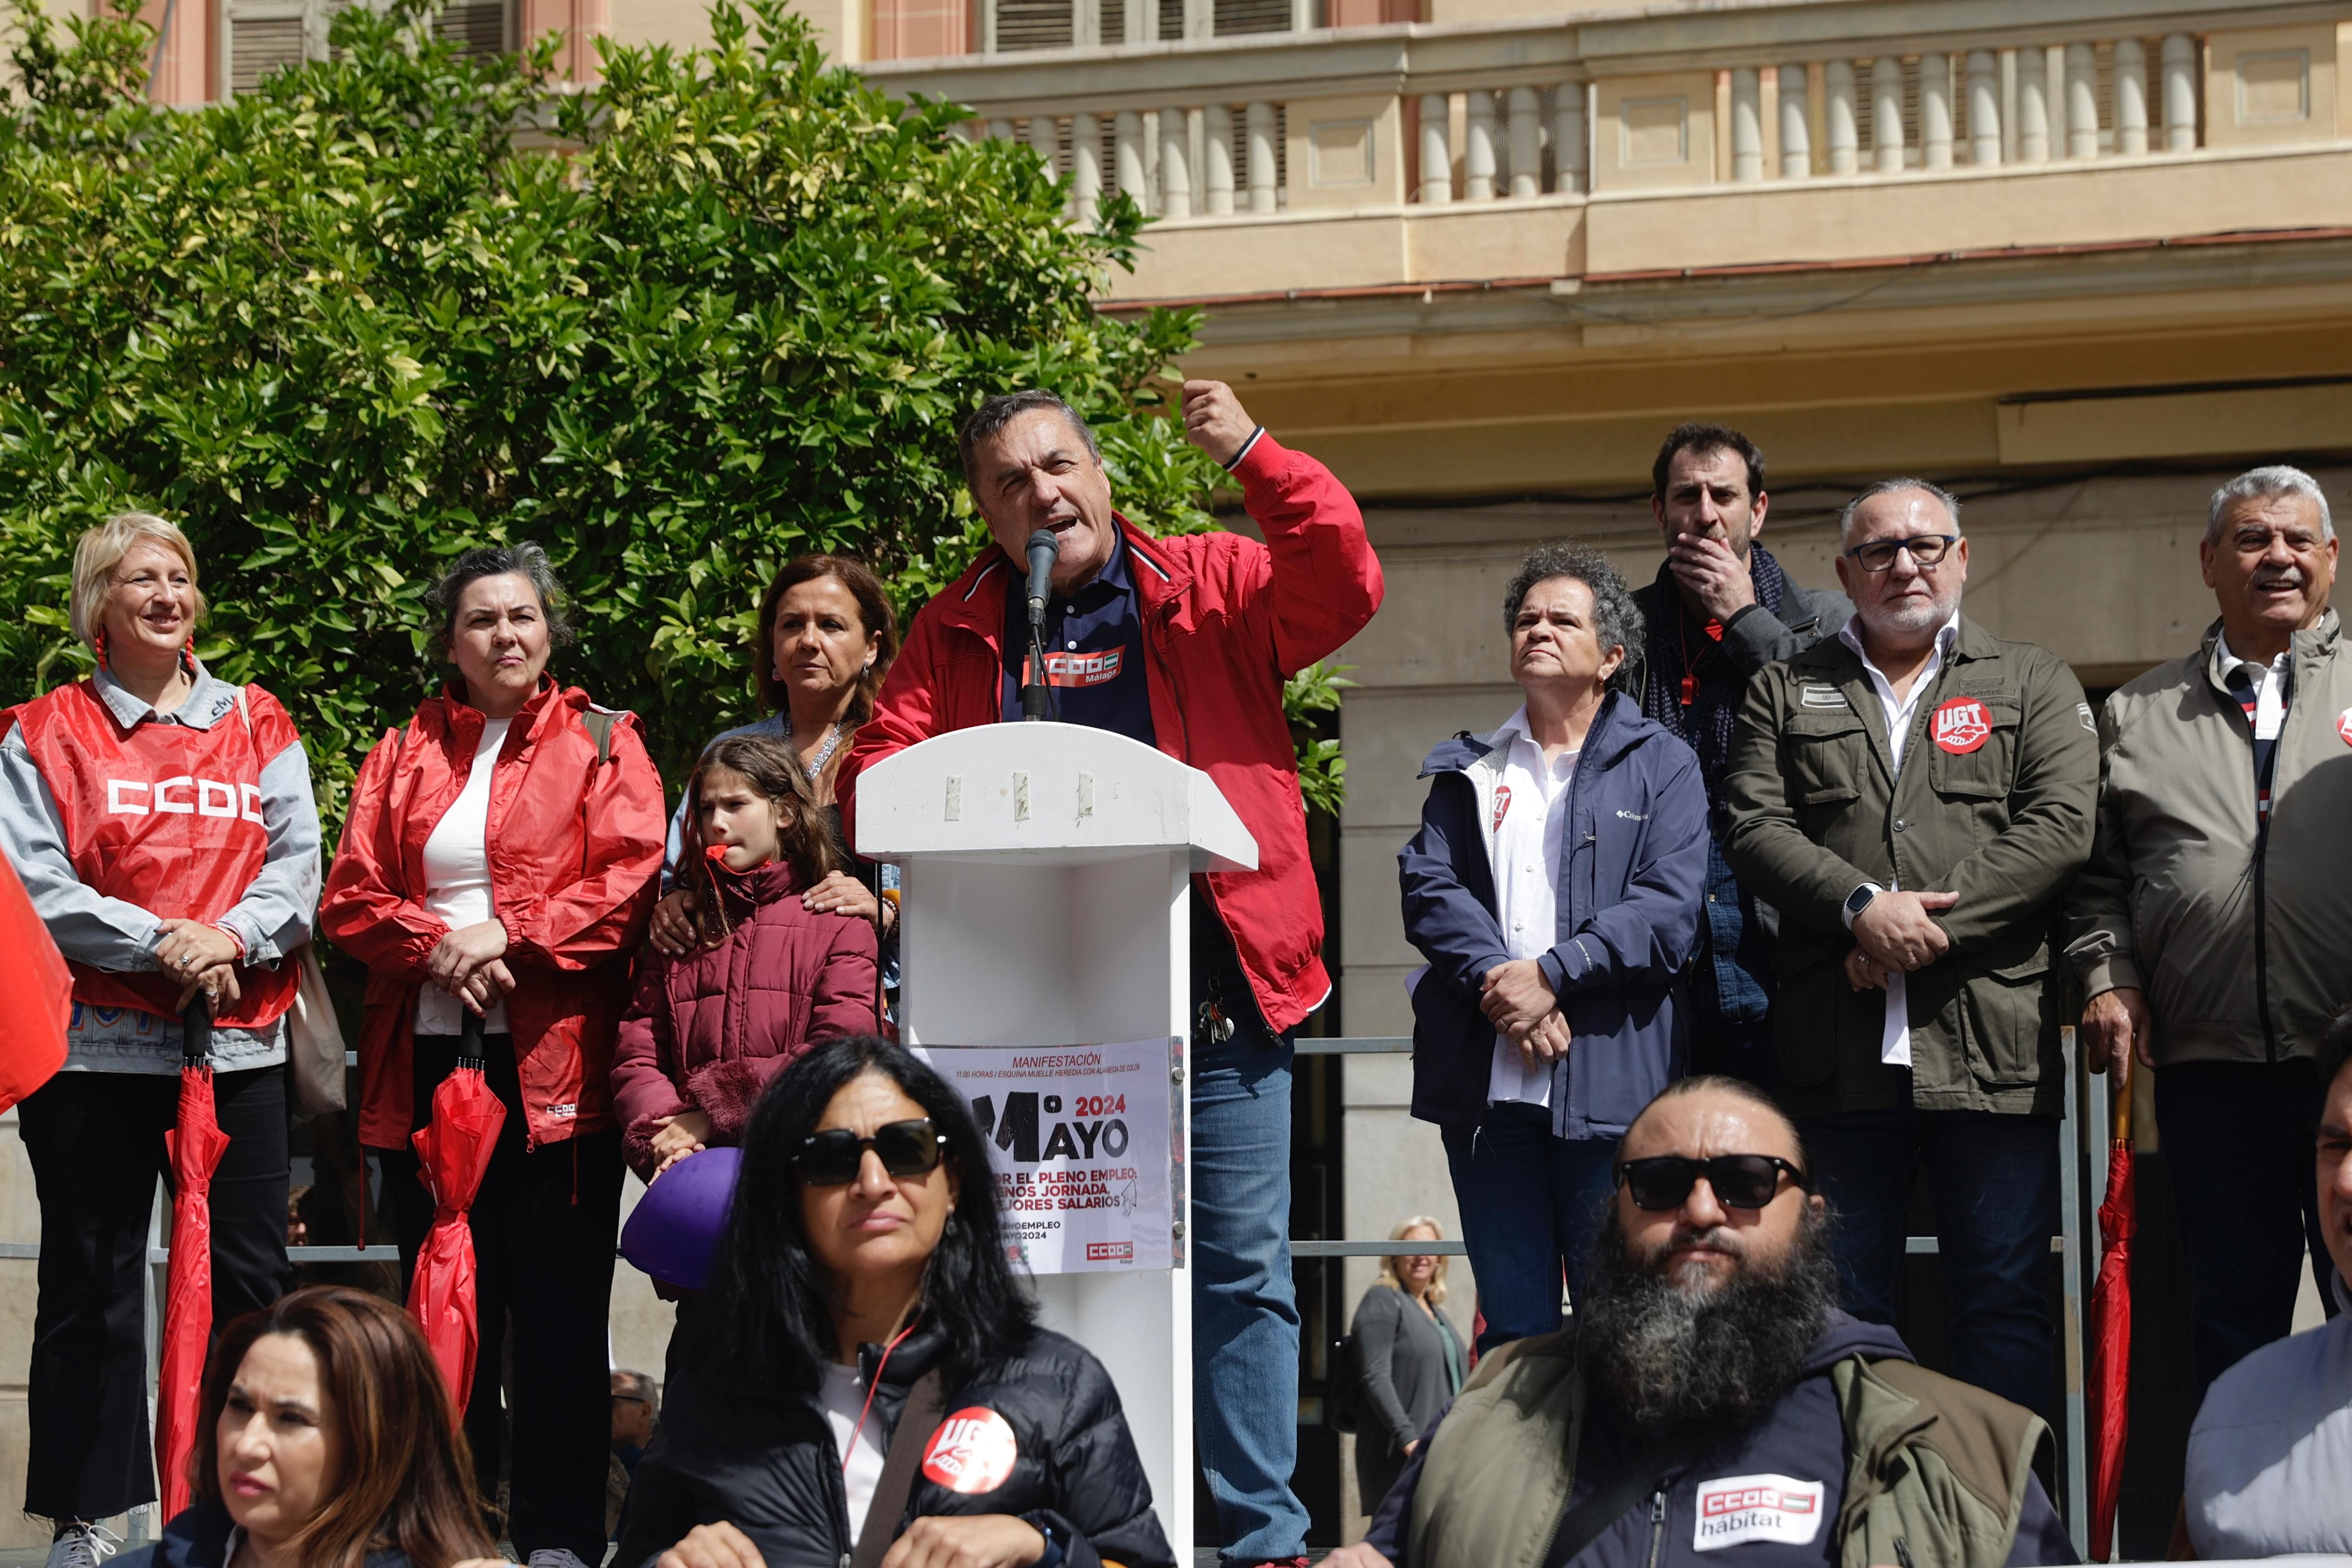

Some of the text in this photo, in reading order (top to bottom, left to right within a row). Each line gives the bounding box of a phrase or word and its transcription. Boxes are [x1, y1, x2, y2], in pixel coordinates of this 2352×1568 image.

[1042, 657, 1103, 675] COO
[1086, 669, 1117, 683] Málaga
[1938, 703, 1981, 733] UGT
[1013, 1052, 1101, 1068] MANIFESTACIÓN
[1096, 1065, 1119, 1074] ALAMEDA
[1126, 1062, 1140, 1072] COLÓN
[547, 1103, 576, 1114] CCOO
[1075, 1093, 1126, 1116] 2024
[1016, 1172, 1034, 1184] EL
[1039, 1170, 1087, 1184] PLENO
[1091, 1167, 1137, 1181] EMPLEO:
[996, 1183, 1110, 1198] ENOS JORNADA,
[1058, 1195, 1120, 1209] SALARIOS
[1089, 1244, 1124, 1257] CCOO
[1707, 1489, 1780, 1513] CCOO
[1701, 1512, 1782, 1536] hábitat
